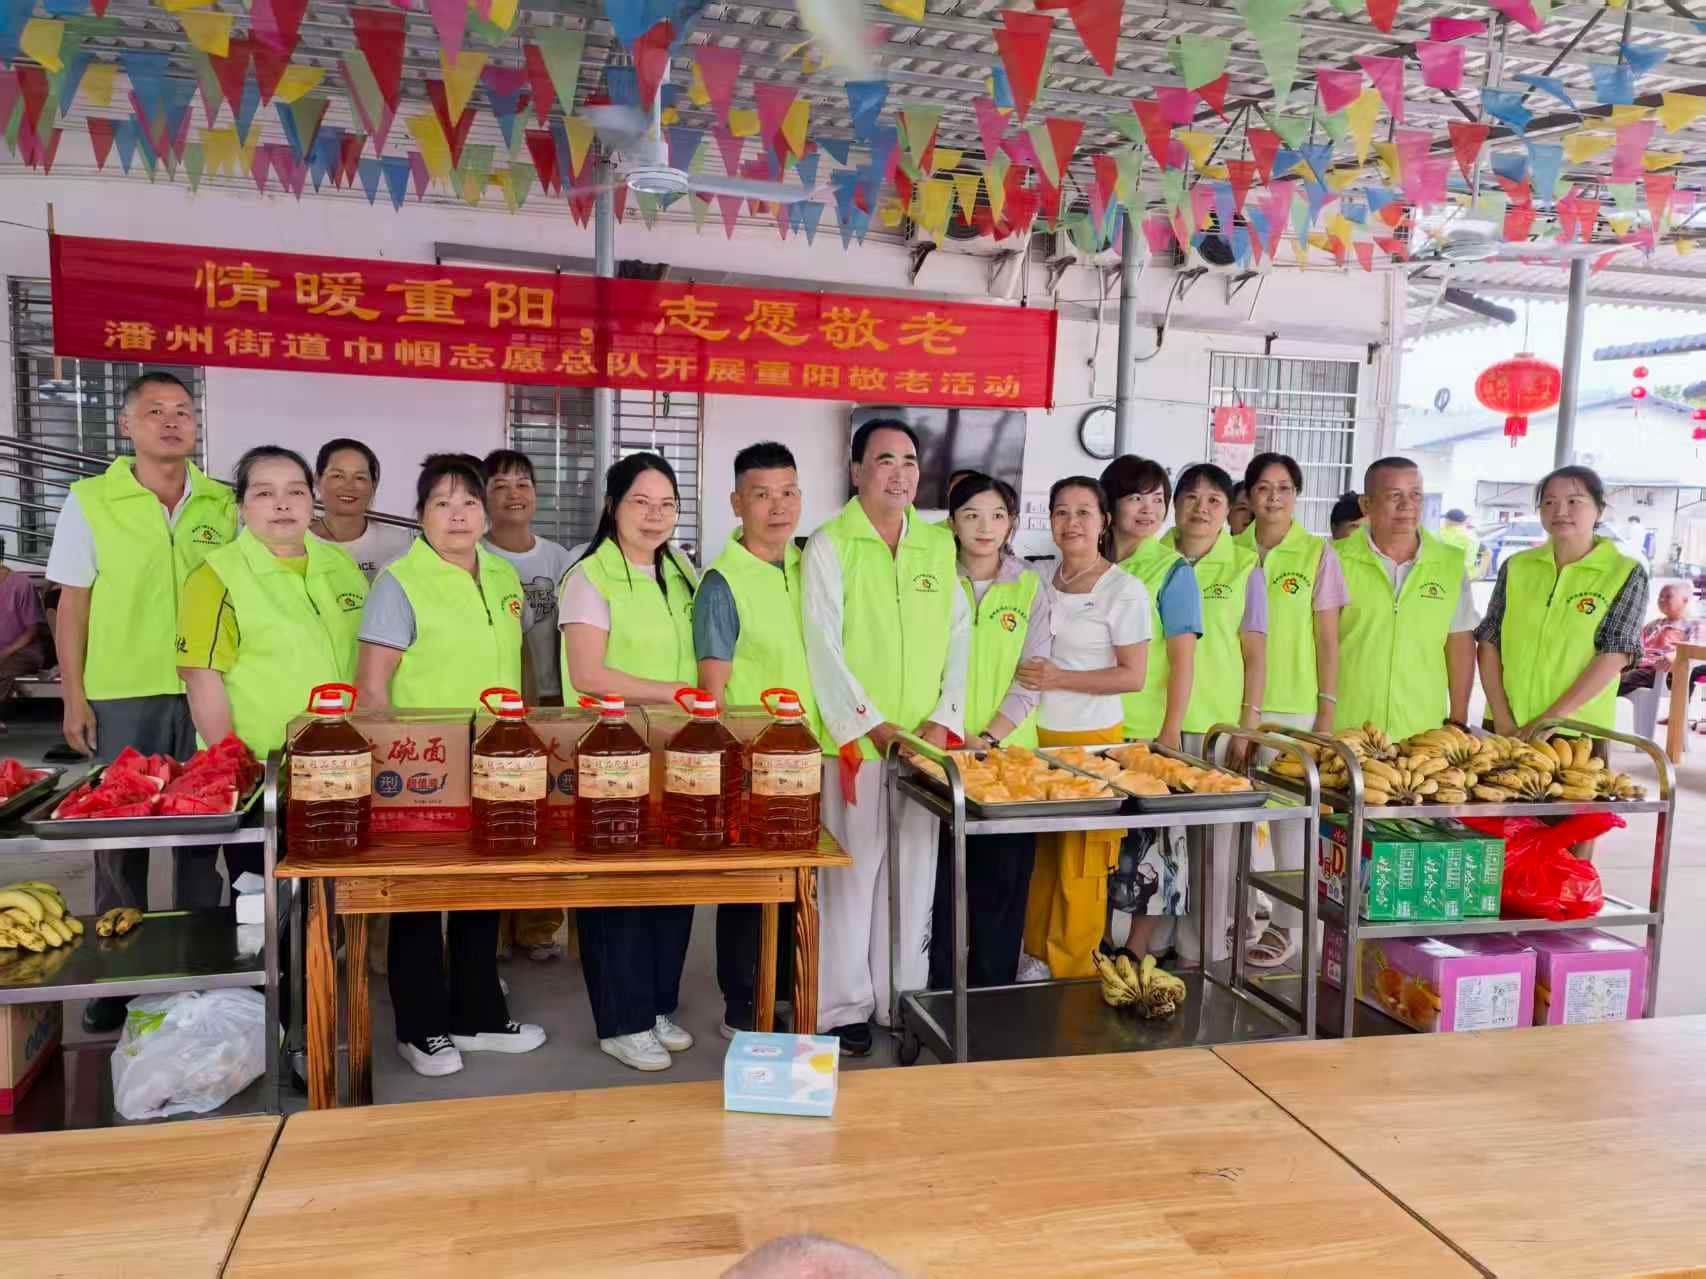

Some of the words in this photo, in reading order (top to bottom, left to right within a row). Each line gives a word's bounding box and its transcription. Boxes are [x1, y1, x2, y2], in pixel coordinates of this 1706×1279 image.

[104, 320, 1022, 400] 潘州街道巾帼志愿总队开展重阳敬老活动
